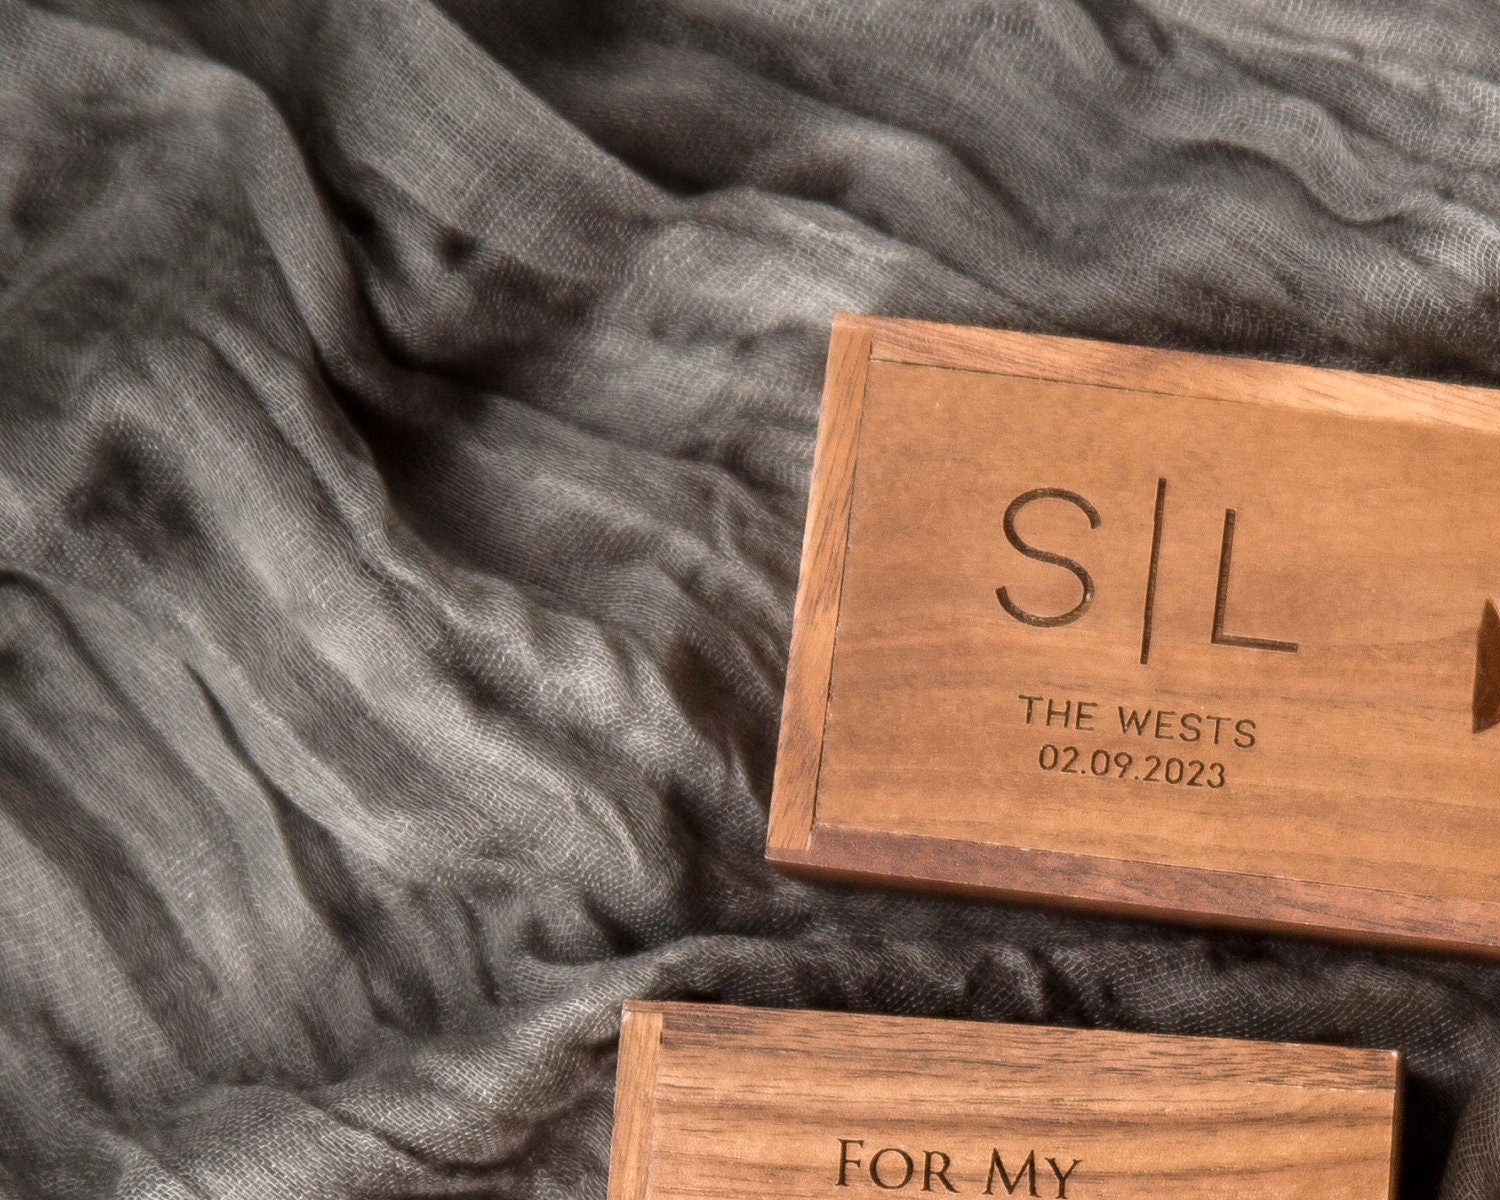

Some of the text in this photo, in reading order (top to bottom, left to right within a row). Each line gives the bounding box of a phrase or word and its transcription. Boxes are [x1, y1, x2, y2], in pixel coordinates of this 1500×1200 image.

[1018, 694, 1257, 749] THE WESTS
[1038, 743, 1227, 789] 02.09.2023
